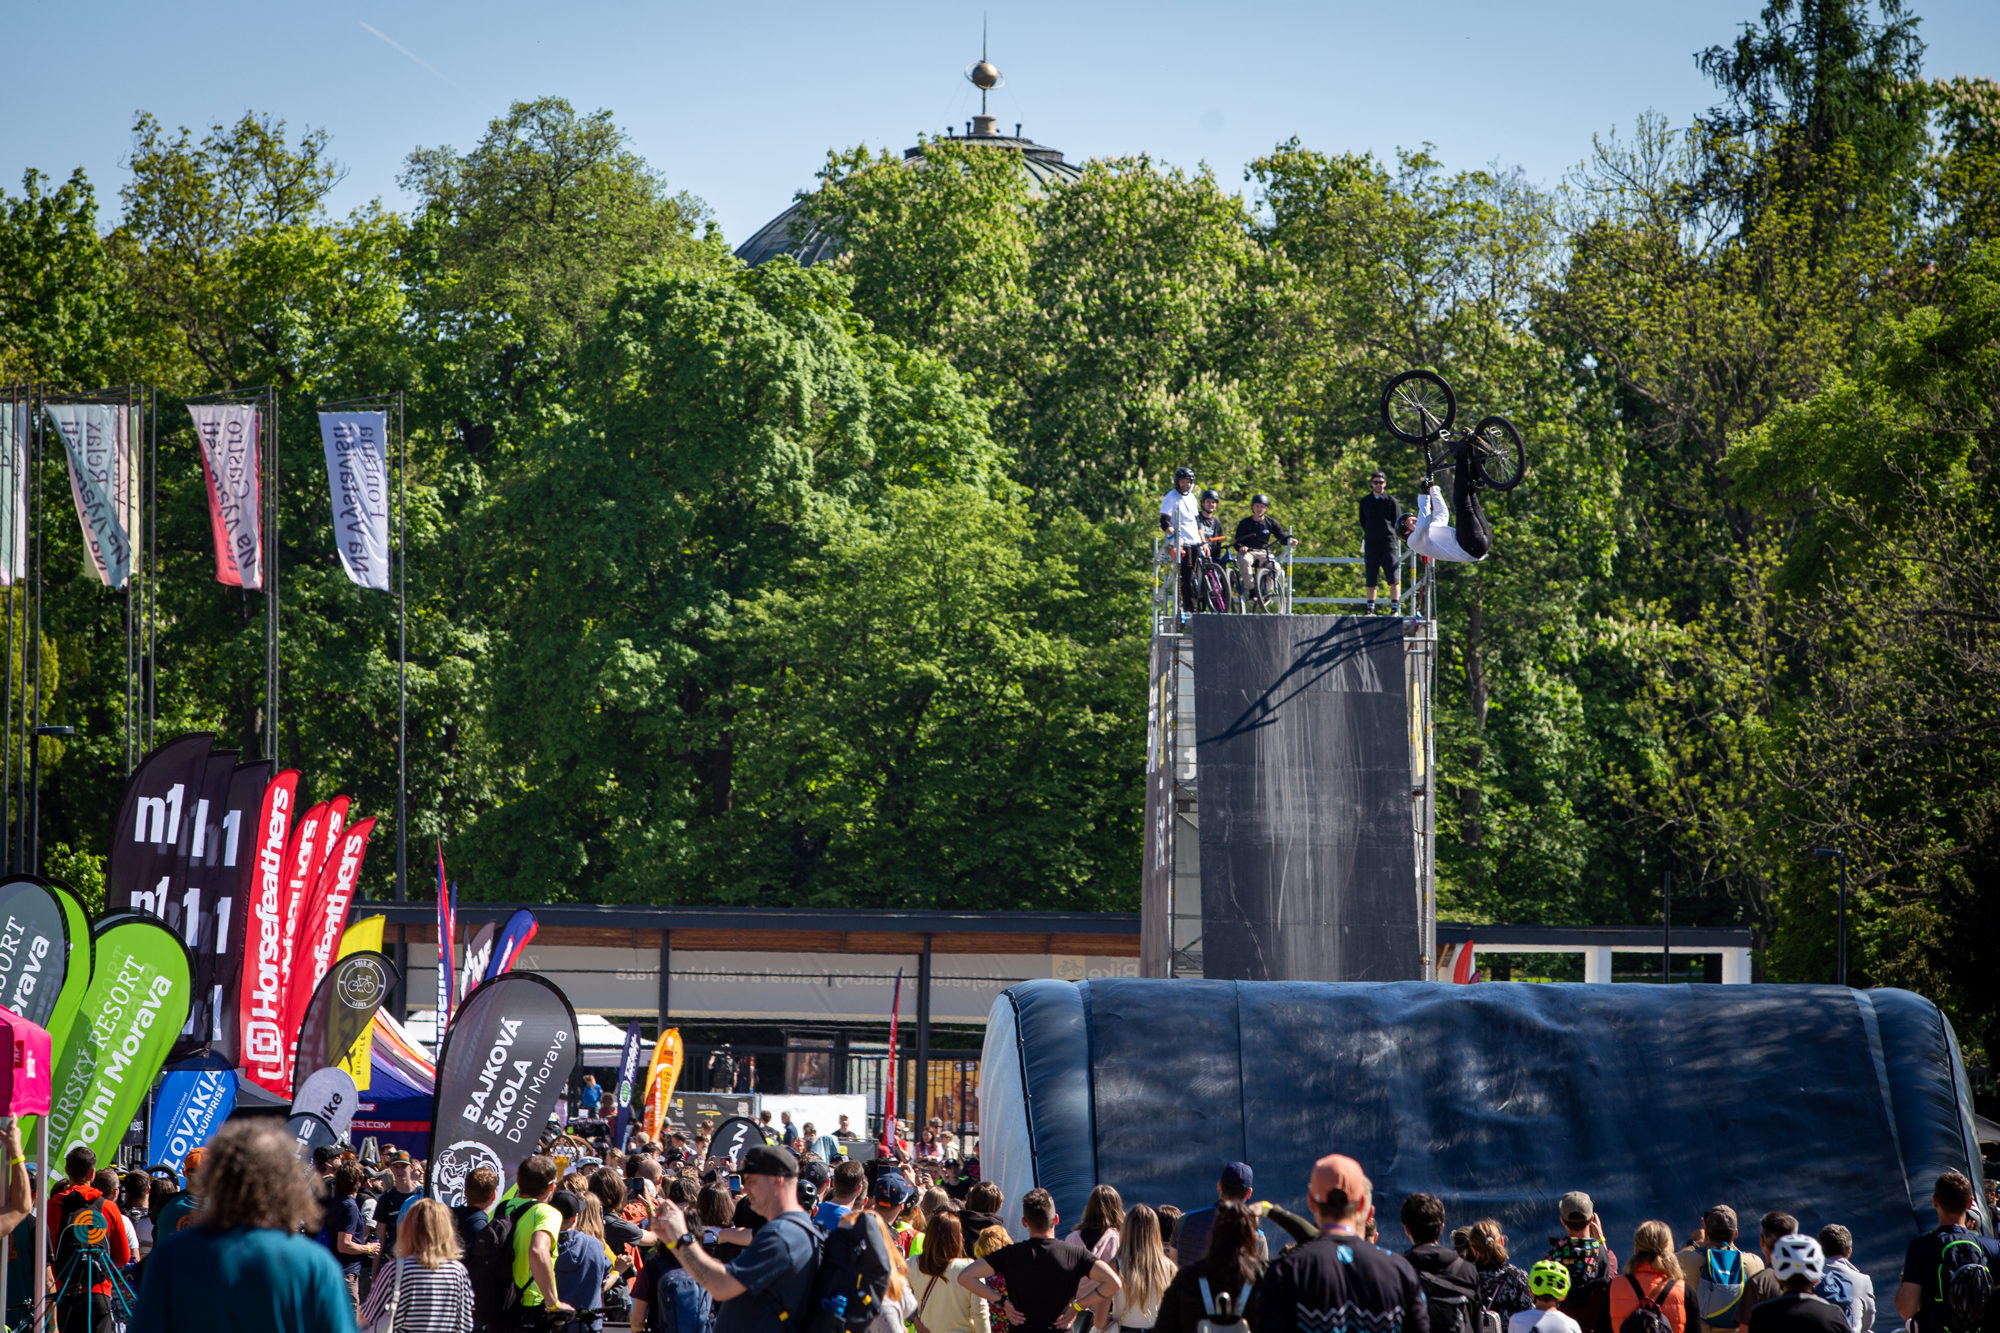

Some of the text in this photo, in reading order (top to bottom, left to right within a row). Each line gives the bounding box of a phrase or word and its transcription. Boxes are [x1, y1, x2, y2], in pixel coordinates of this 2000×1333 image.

[134, 784, 184, 844] n1
[130, 876, 170, 919] n1
[252, 786, 289, 1017] Horsefeathers
[88, 955, 145, 1051] RESORT
[104, 975, 172, 1084] Morava
[199, 1084, 226, 1137] SURPRISE
[462, 1016, 523, 1123] BAJKOVÁ
[482, 1059, 532, 1135] ŠKOLA
[506, 1029, 568, 1144] Dolní Morava
[165, 1091, 188, 1137] www.slovakia.travel
